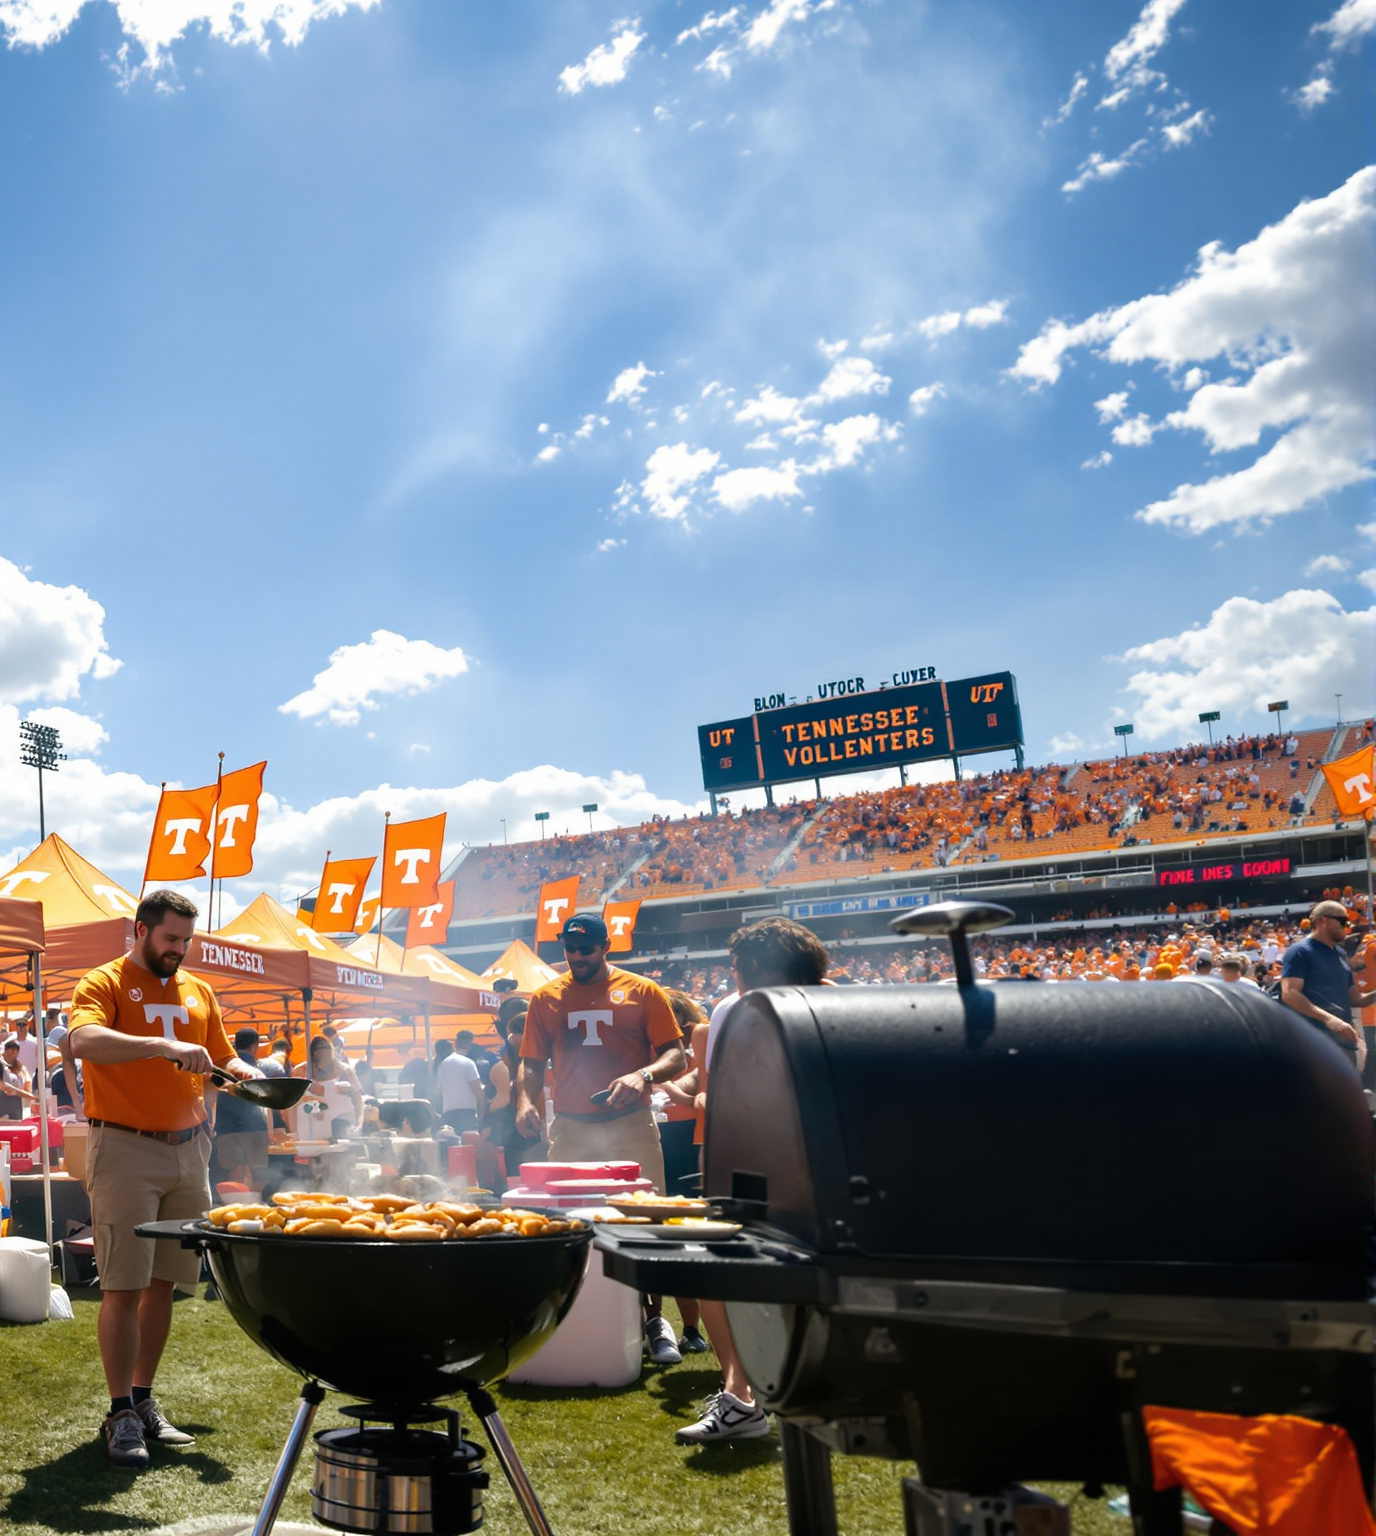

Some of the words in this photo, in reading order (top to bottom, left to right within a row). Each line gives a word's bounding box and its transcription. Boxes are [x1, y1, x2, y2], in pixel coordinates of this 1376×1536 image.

[709, 728, 735, 747] UT
[781, 705, 919, 743] TENNESSEE
[784, 728, 934, 766] VOLLENTERS
[1344, 772, 1373, 804] T
[164, 818, 202, 855] T
[217, 804, 249, 848] T
[395, 848, 431, 884] T
[328, 882, 356, 914] T
[417, 903, 444, 928] T
[544, 898, 569, 924] T
[610, 916, 631, 936] T
[143, 1003, 190, 1041] T
[567, 1009, 614, 1046] T
